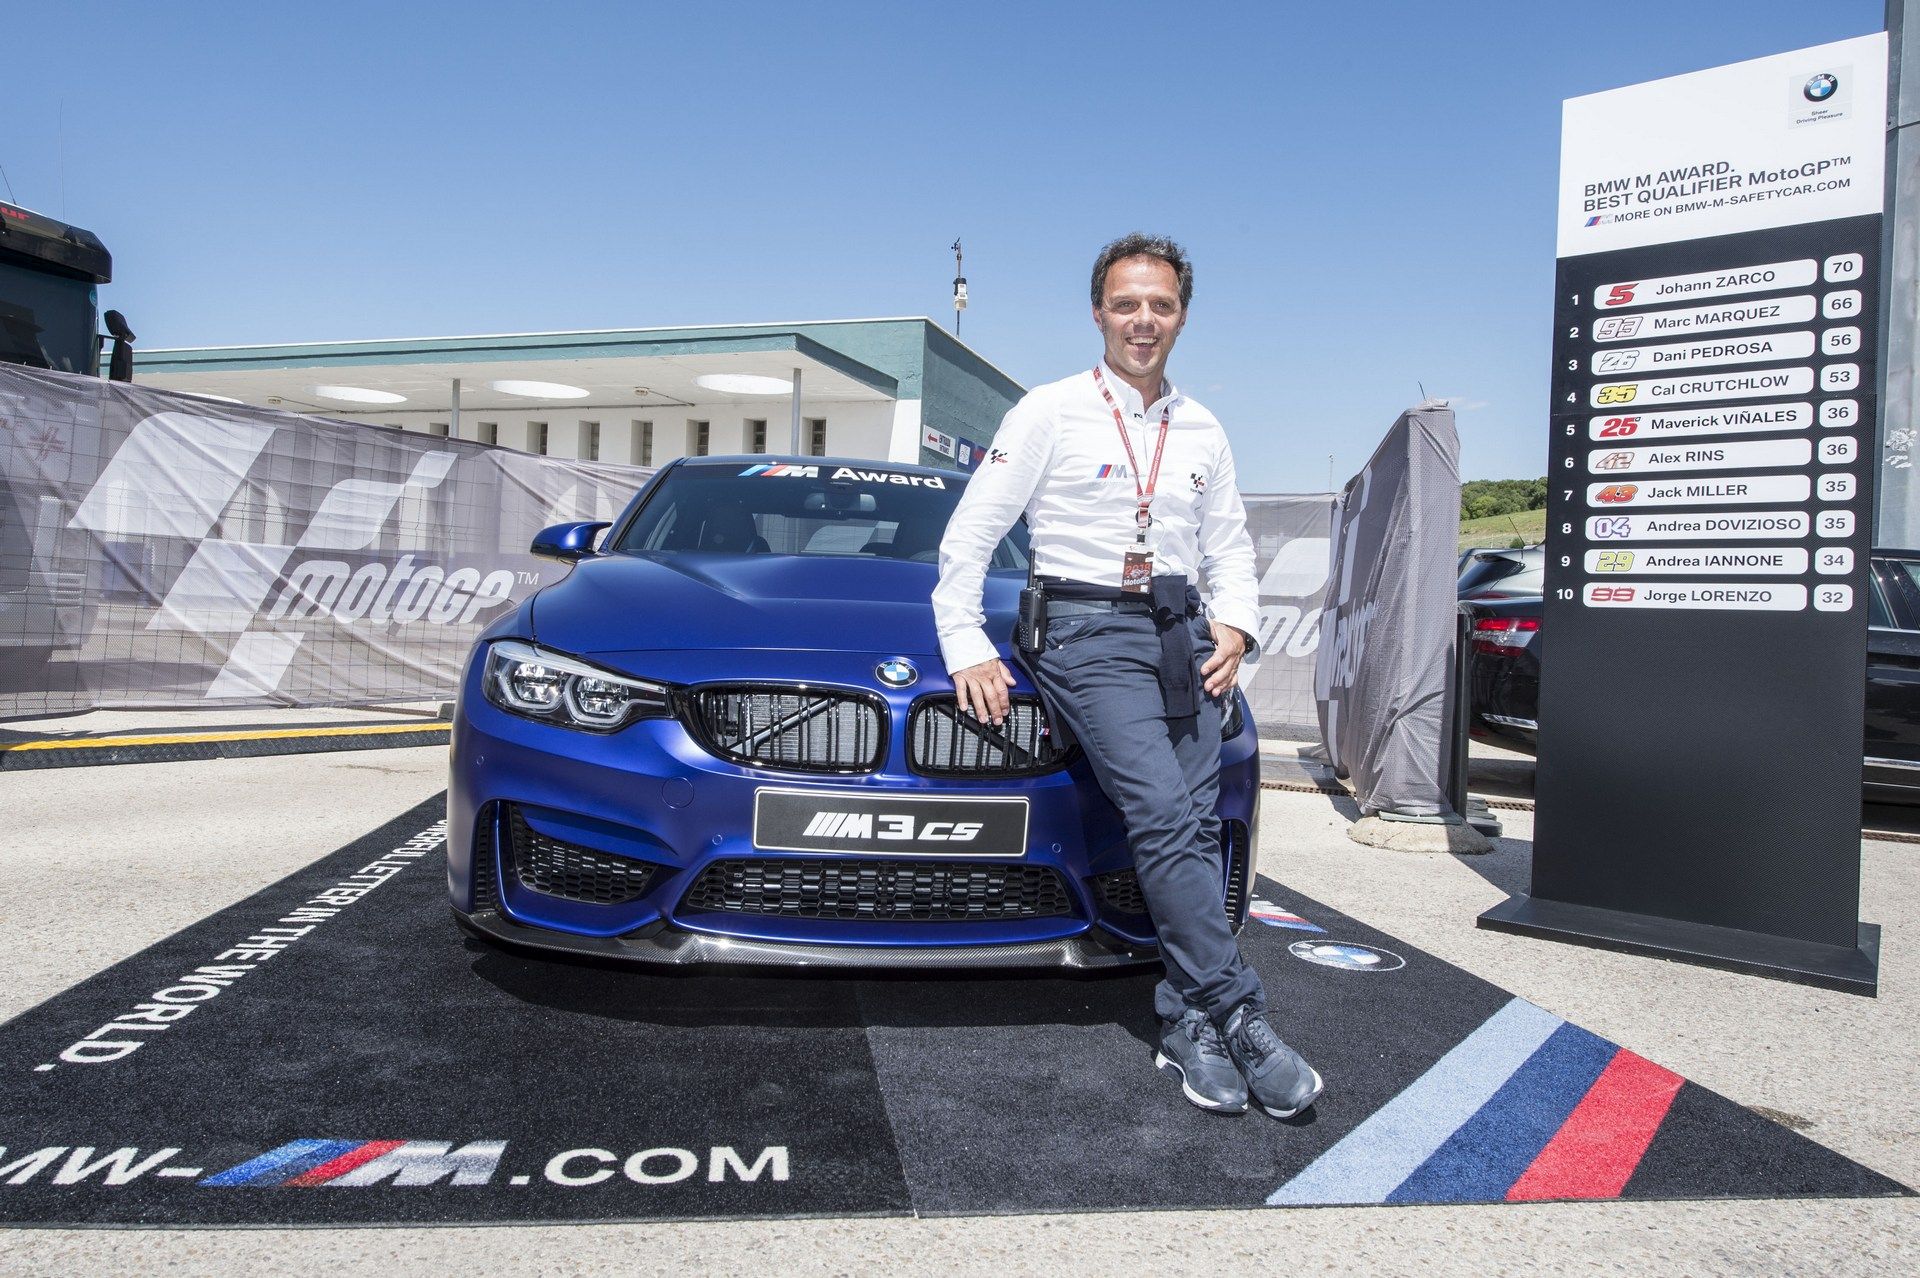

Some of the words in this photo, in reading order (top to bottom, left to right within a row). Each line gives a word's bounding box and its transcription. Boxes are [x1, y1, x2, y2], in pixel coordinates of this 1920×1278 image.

[1796, 116, 1817, 125] Driving
[1817, 112, 1843, 120] Pleasure
[1584, 192, 1633, 212] BEST
[1637, 175, 1742, 204] QUALIFIER
[1585, 177, 1630, 197] BMW
[1635, 174, 1651, 188] M
[1656, 161, 1735, 185] AWARD.
[1614, 209, 1650, 222] MORE
[1653, 206, 1672, 217] ON
[1675, 178, 1851, 214] BMW-M-SAFETYCAR.COM
[1572, 294, 1579, 306] 1
[1605, 283, 1639, 306] 5
[1656, 279, 1712, 296] Johann
[1716, 270, 1776, 289] ZARCO
[1833, 260, 1854, 274] 70
[1569, 327, 1579, 339] 2
[1597, 315, 1643, 340] 93
[1654, 315, 1691, 330] Marc
[1695, 306, 1780, 326] MARQUEZ
[1831, 297, 1853, 311] 66
[1568, 359, 1578, 371] 3
[1599, 350, 1640, 372] 26
[1653, 348, 1687, 364] Dani
[1691, 341, 1773, 360] PEDROSA
[1830, 334, 1852, 348] 56
[1567, 392, 1577, 403] 4
[1597, 384, 1638, 405] 35
[1651, 381, 1676, 397] Cal
[1679, 375, 1789, 394] CRUTCHLOW
[1829, 370, 1851, 384] 53
[1566, 425, 1575, 436] 5
[1599, 417, 1640, 438] 25
[1651, 415, 1719, 430] Maverick
[1722, 409, 1797, 425] VIÑALES
[1828, 406, 1849, 420] 36
[1565, 457, 1574, 469] 6
[1648, 451, 1681, 464] Alex
[1685, 449, 1725, 463] RINS
[1826, 442, 1848, 456] 36
[831, 468, 946, 490] Award
[1564, 490, 1573, 501] 7
[1595, 484, 1638, 504] 43
[1647, 486, 1682, 499] Jack
[1687, 484, 1748, 498] MILLER
[1825, 480, 1847, 493] 35
[1562, 523, 1572, 534] 8
[1594, 517, 1631, 538] 04
[1647, 520, 1701, 533] Andrea
[1705, 518, 1801, 531] DOVIZIOSO
[1824, 517, 1846, 530] 35
[1561, 556, 1571, 567] 9
[1595, 551, 1635, 572] 29
[1646, 555, 1700, 567] Andrea
[1704, 555, 1783, 567] IANNONE
[1823, 554, 1845, 567] 34
[1556, 589, 1574, 600] 10
[1644, 590, 1687, 605] Jorge
[1691, 590, 1772, 603] LORENZO
[1822, 592, 1843, 604] 32
[306, 861, 412, 906] LETTER
[278, 907, 343, 922] IN
[214, 925, 317, 961] THE
[33, 964, 257, 1072] WORLD.
